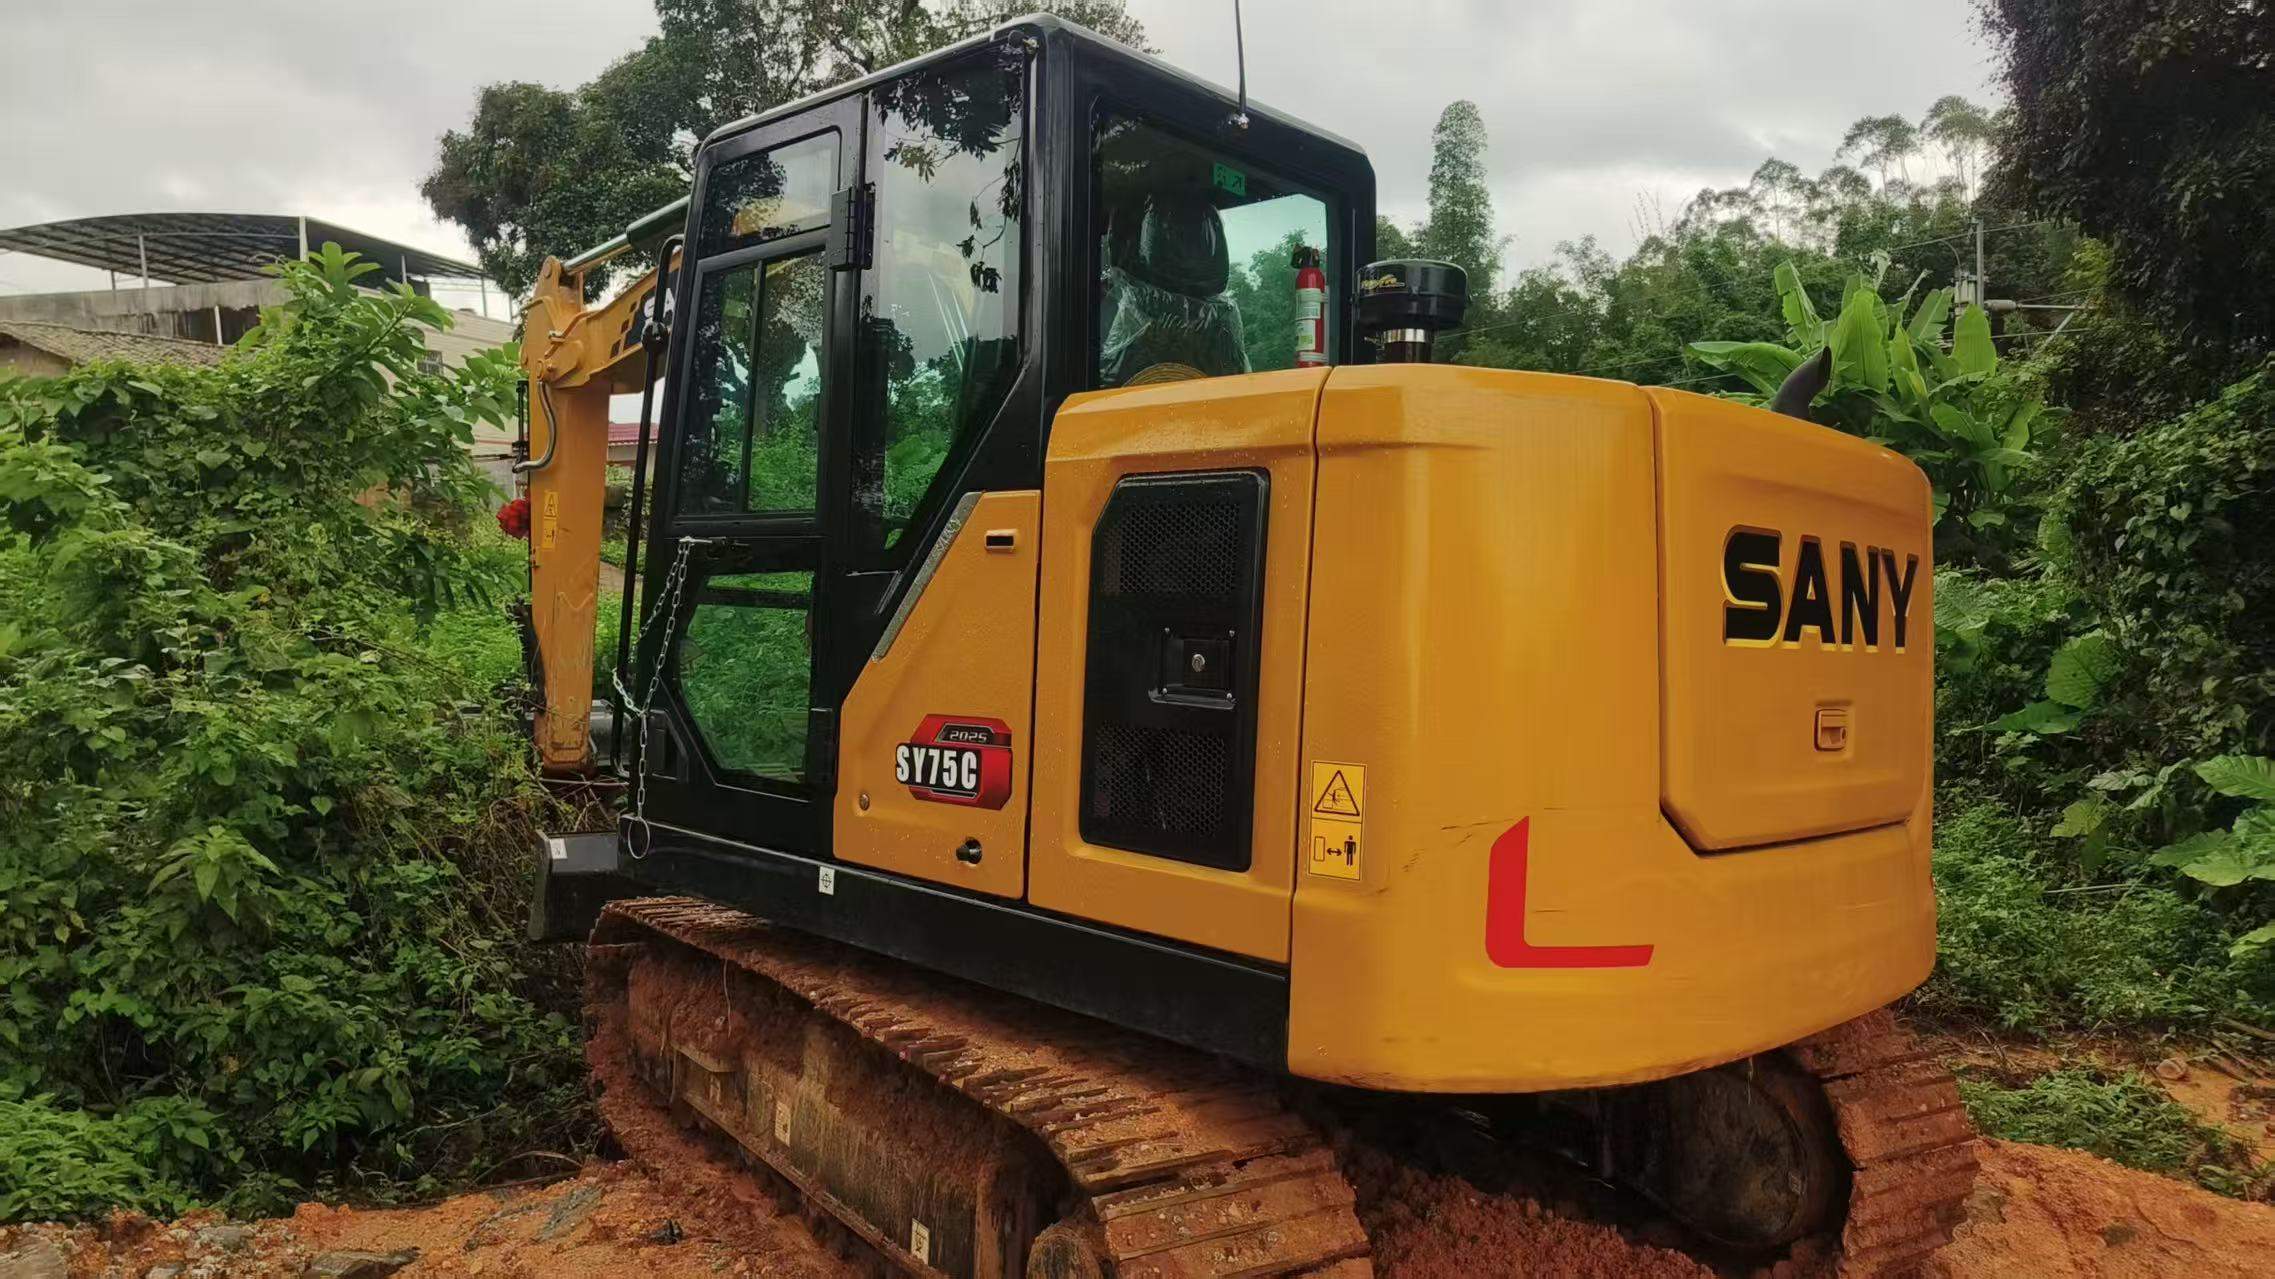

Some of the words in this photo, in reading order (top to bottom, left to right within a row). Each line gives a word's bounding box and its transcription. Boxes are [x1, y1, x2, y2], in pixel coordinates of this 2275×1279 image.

[1721, 525, 1919, 654] SANY
[949, 730, 988, 743] 2025
[896, 745, 977, 789] SY75C
